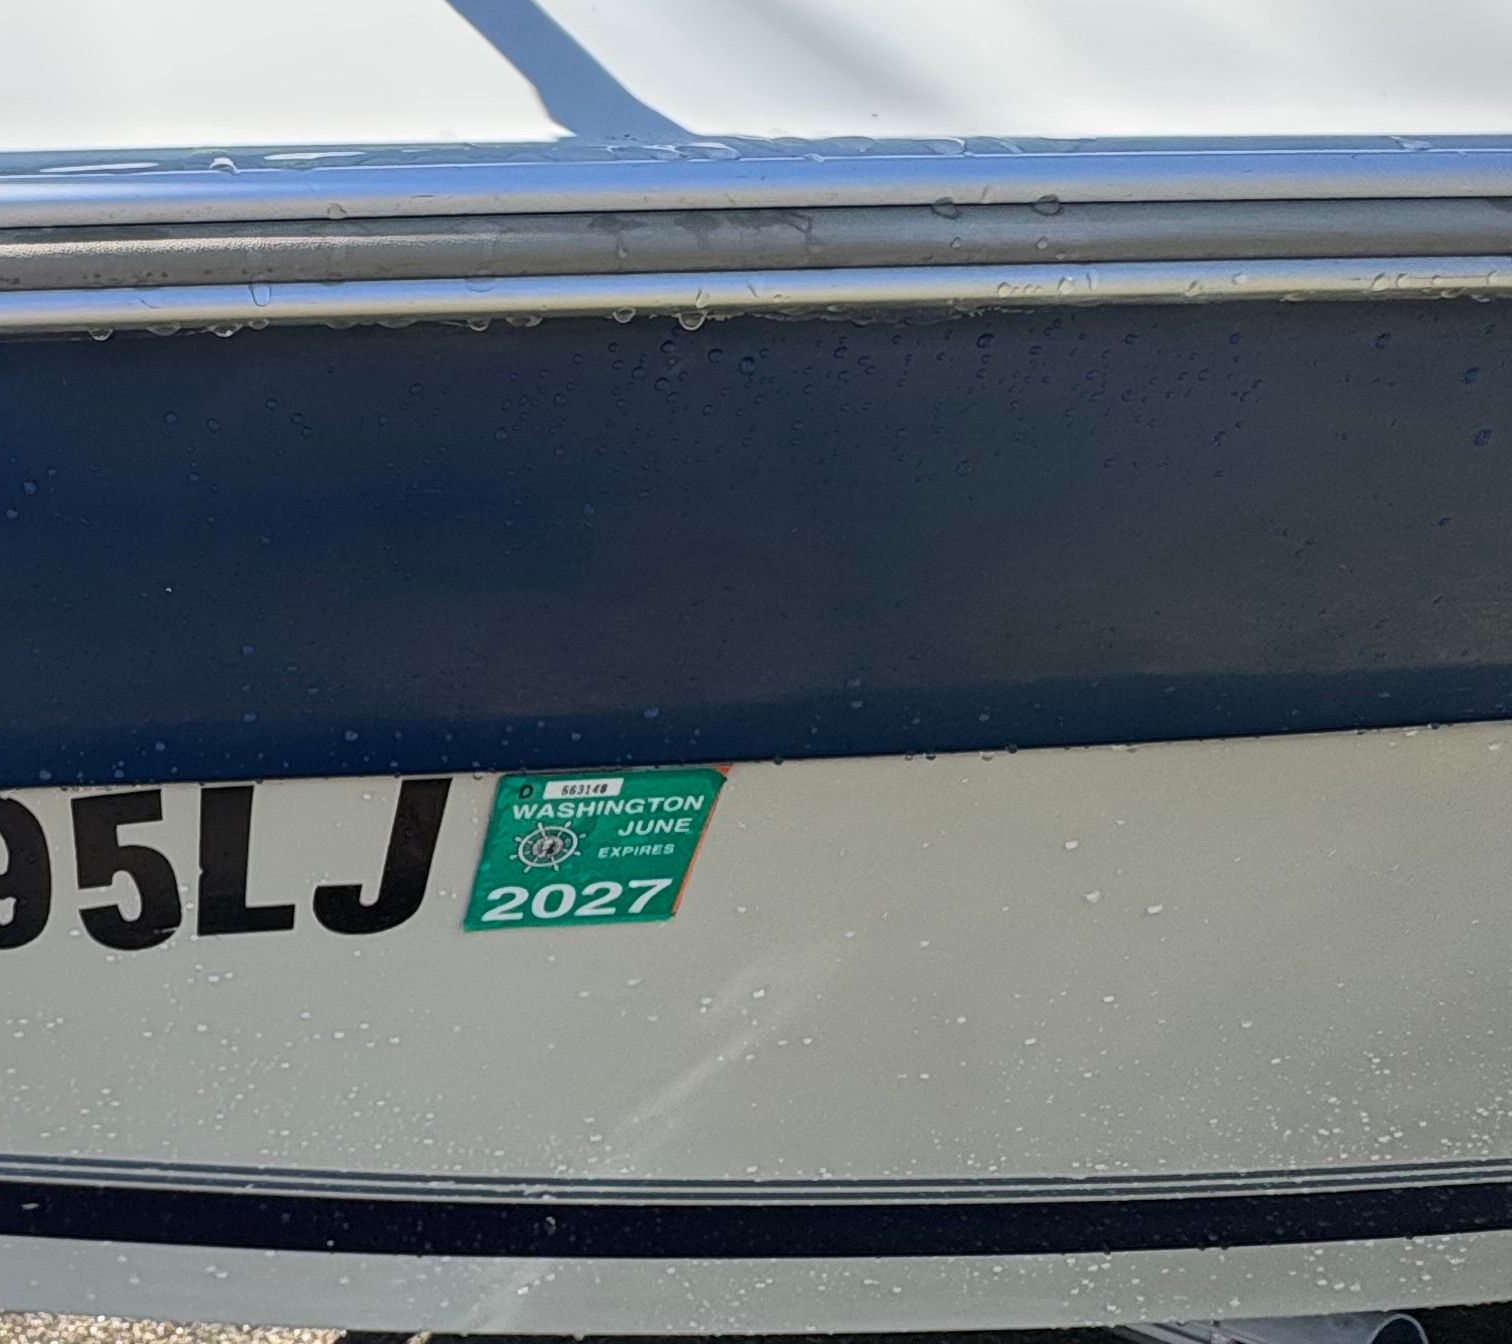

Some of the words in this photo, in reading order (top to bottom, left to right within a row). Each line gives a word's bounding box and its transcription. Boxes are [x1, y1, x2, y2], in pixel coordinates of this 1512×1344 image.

[513, 795, 705, 820] WASHINGTON
[618, 818, 693, 837] JUNE
[598, 843, 675, 859] EXPIRES
[481, 878, 673, 922] 2027
